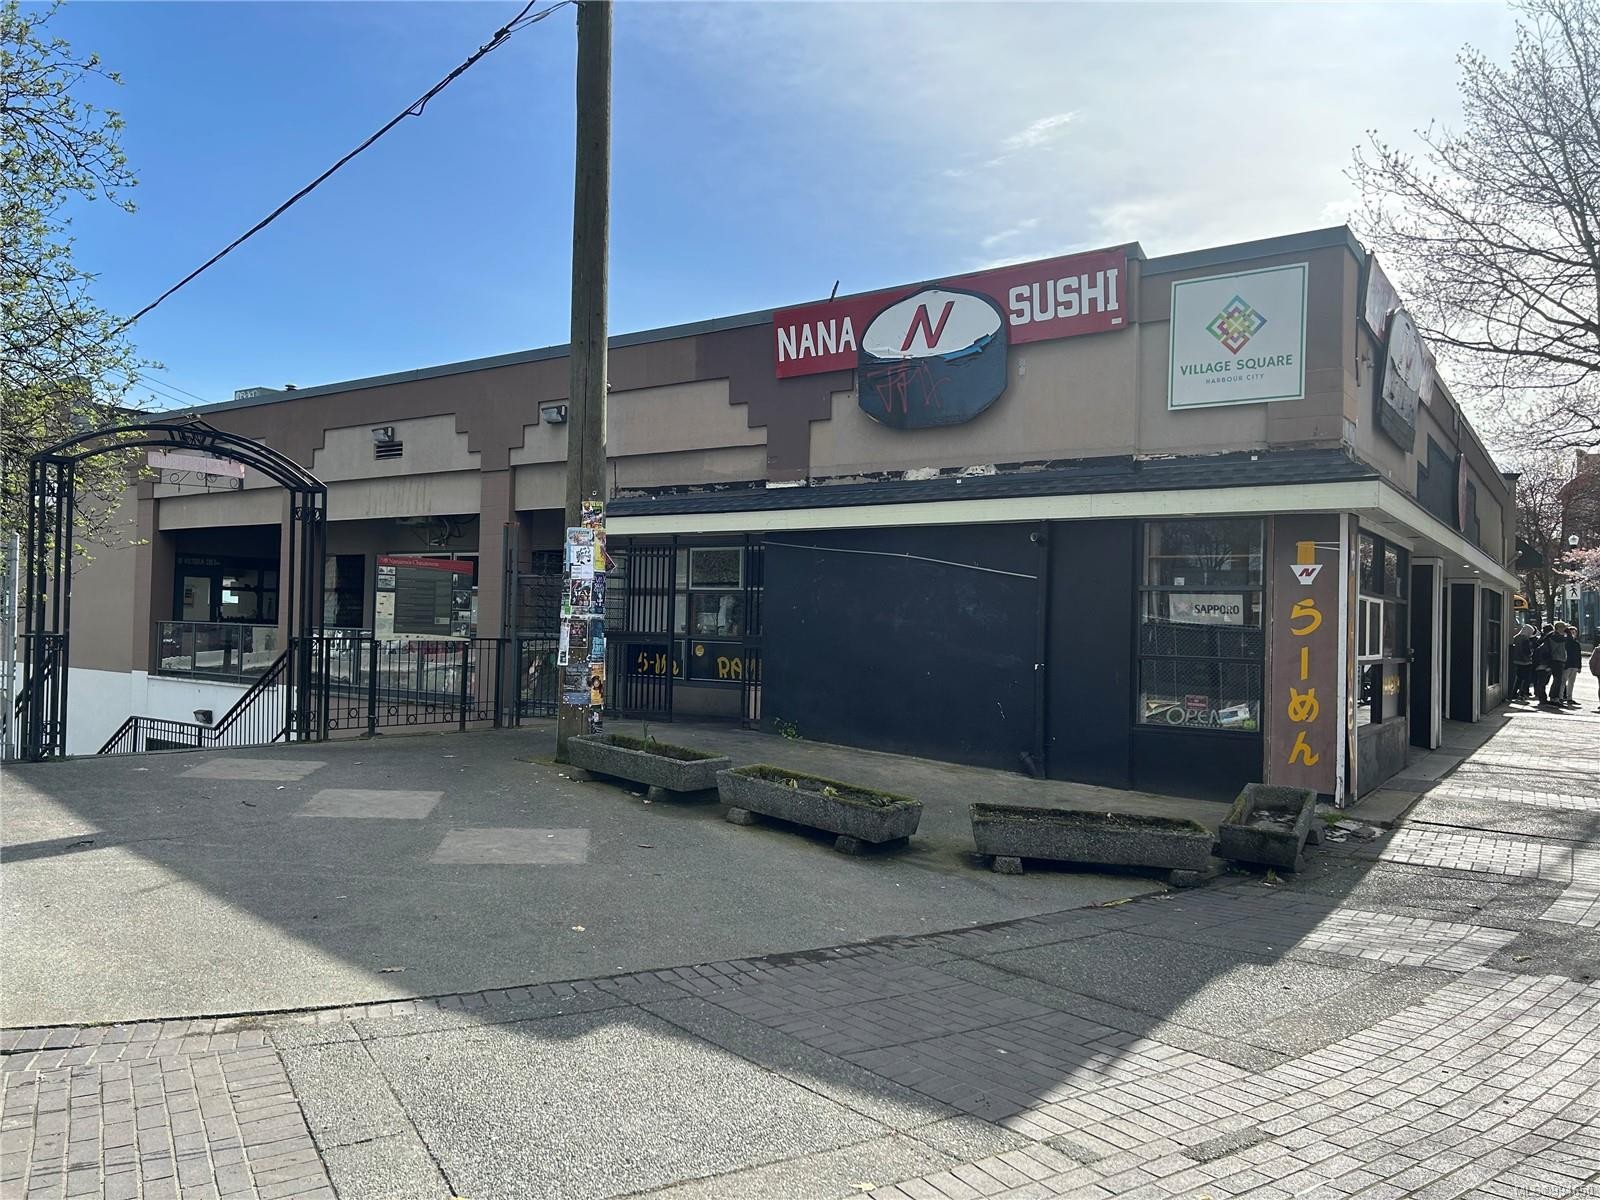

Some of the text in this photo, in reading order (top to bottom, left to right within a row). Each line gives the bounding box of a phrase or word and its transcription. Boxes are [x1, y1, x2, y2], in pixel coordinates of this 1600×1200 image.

[776, 268, 1119, 363] NANA N SUSHI
[1180, 354, 1293, 376] VILLAGE SQUARE
[1205, 373, 1264, 385] HARBOUR CITY
[1194, 604, 1240, 615] SAPPORO
[1288, 598, 1322, 767] らーめん
[1166, 707, 1222, 726] OPEN
